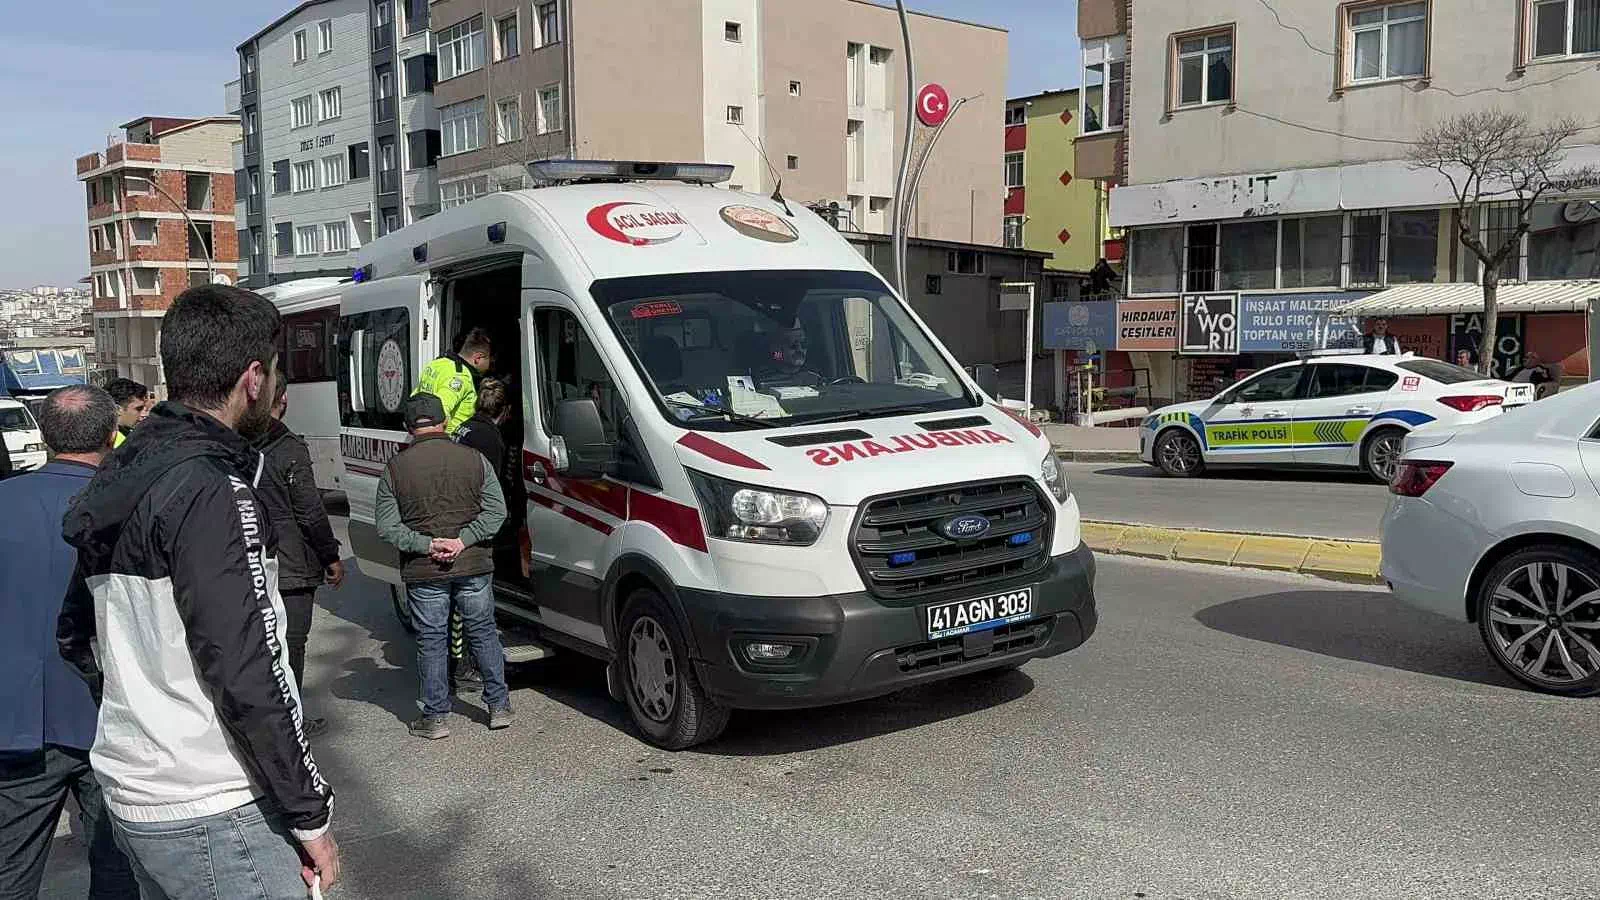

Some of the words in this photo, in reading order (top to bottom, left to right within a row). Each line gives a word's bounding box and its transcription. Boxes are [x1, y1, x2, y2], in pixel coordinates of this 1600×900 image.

[1121, 310, 1177, 322] HIRDAVAT
[1252, 315, 1284, 327] RULO
[1286, 315, 1321, 328] FIRÇ
[1243, 329, 1288, 340] TOPTAN
[1290, 331, 1304, 340] ve
[1212, 427, 1249, 441] TRAFİK
[1251, 426, 1288, 440] POLİSİ
[341, 434, 400, 463] AMBULANS
[236, 500, 261, 548] TURN
[957, 518, 984, 535] Ford
[247, 551, 265, 600] YOUR
[932, 606, 952, 630] 41
[954, 598, 995, 627] AGN
[997, 591, 1029, 617] 303
[260, 607, 281, 656] TURN
